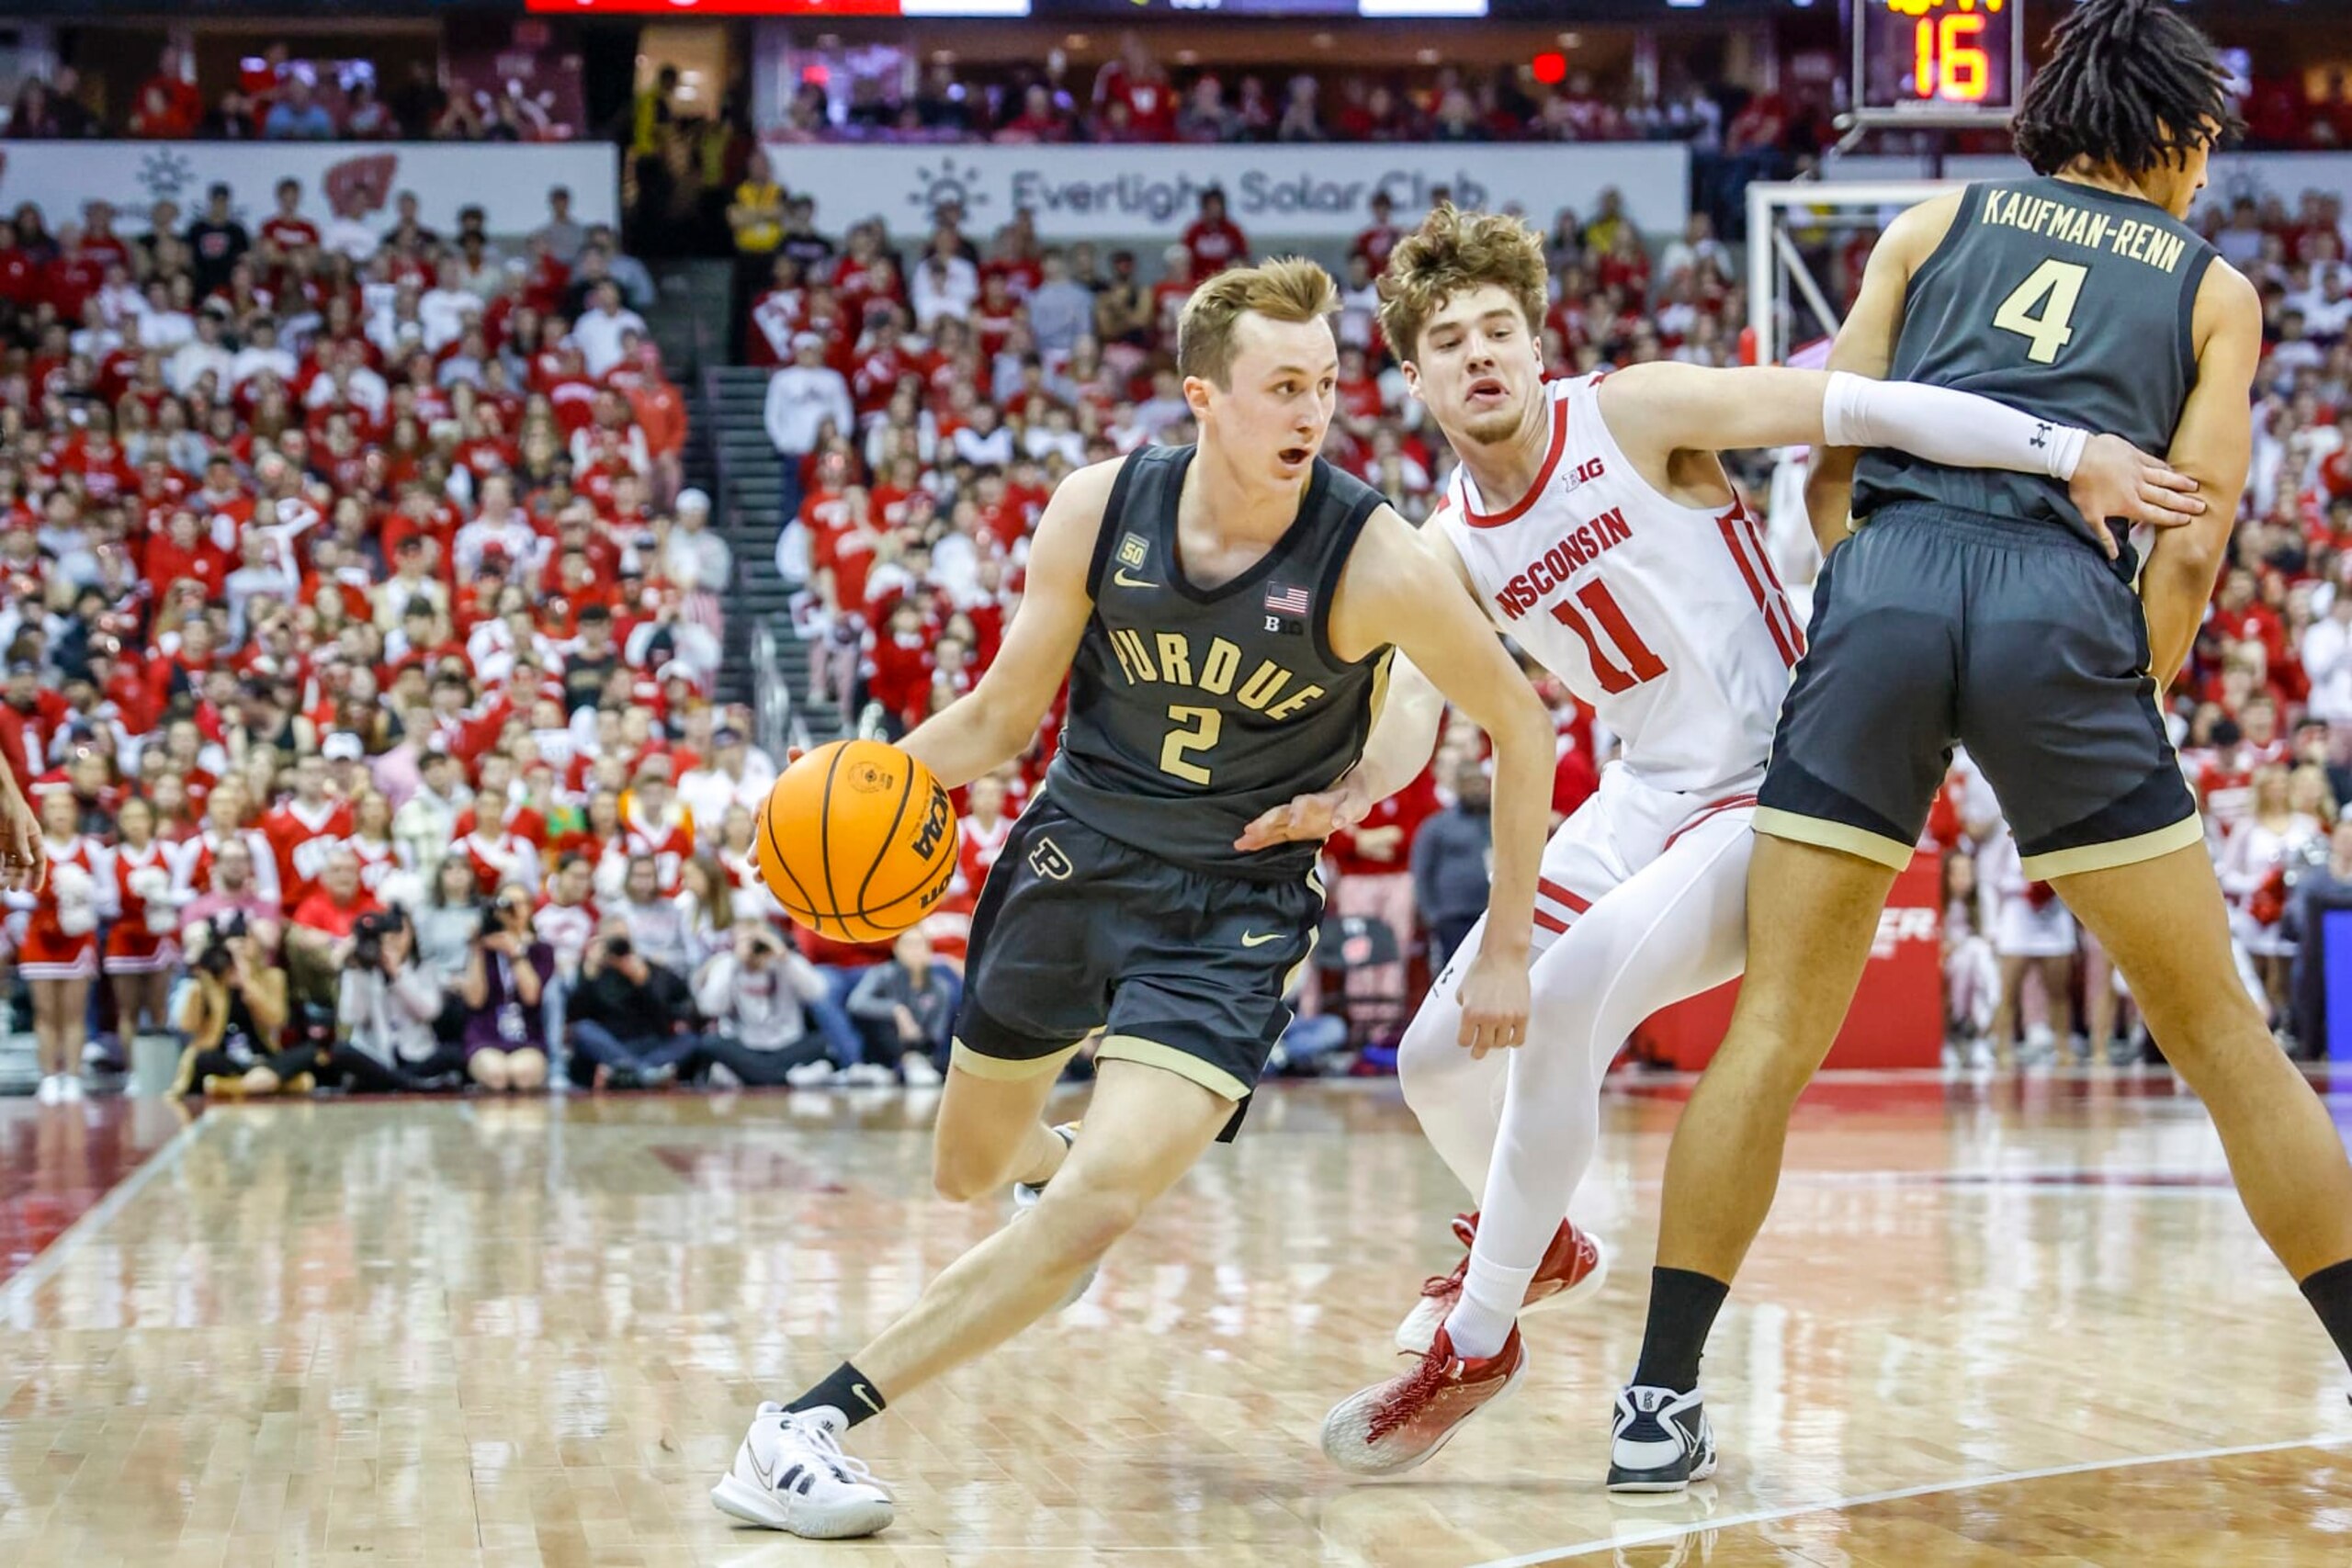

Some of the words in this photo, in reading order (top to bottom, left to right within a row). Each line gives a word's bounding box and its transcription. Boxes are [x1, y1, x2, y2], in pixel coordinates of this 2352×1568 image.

[1916, 14, 1987, 101] 16
[1012, 170, 1220, 223] Everligh
[1240, 169, 1366, 214] Solar
[1376, 170, 1487, 214] Clb
[1982, 189, 2186, 273] KAUFMAN-RENN
[1992, 258, 2090, 365] 4
[1121, 541, 1145, 565] 50
[1107, 628, 1326, 721] PURDUE
[1550, 577, 1668, 694] 11
[1159, 704, 1223, 785] 2
[911, 775, 949, 862] NCAA
